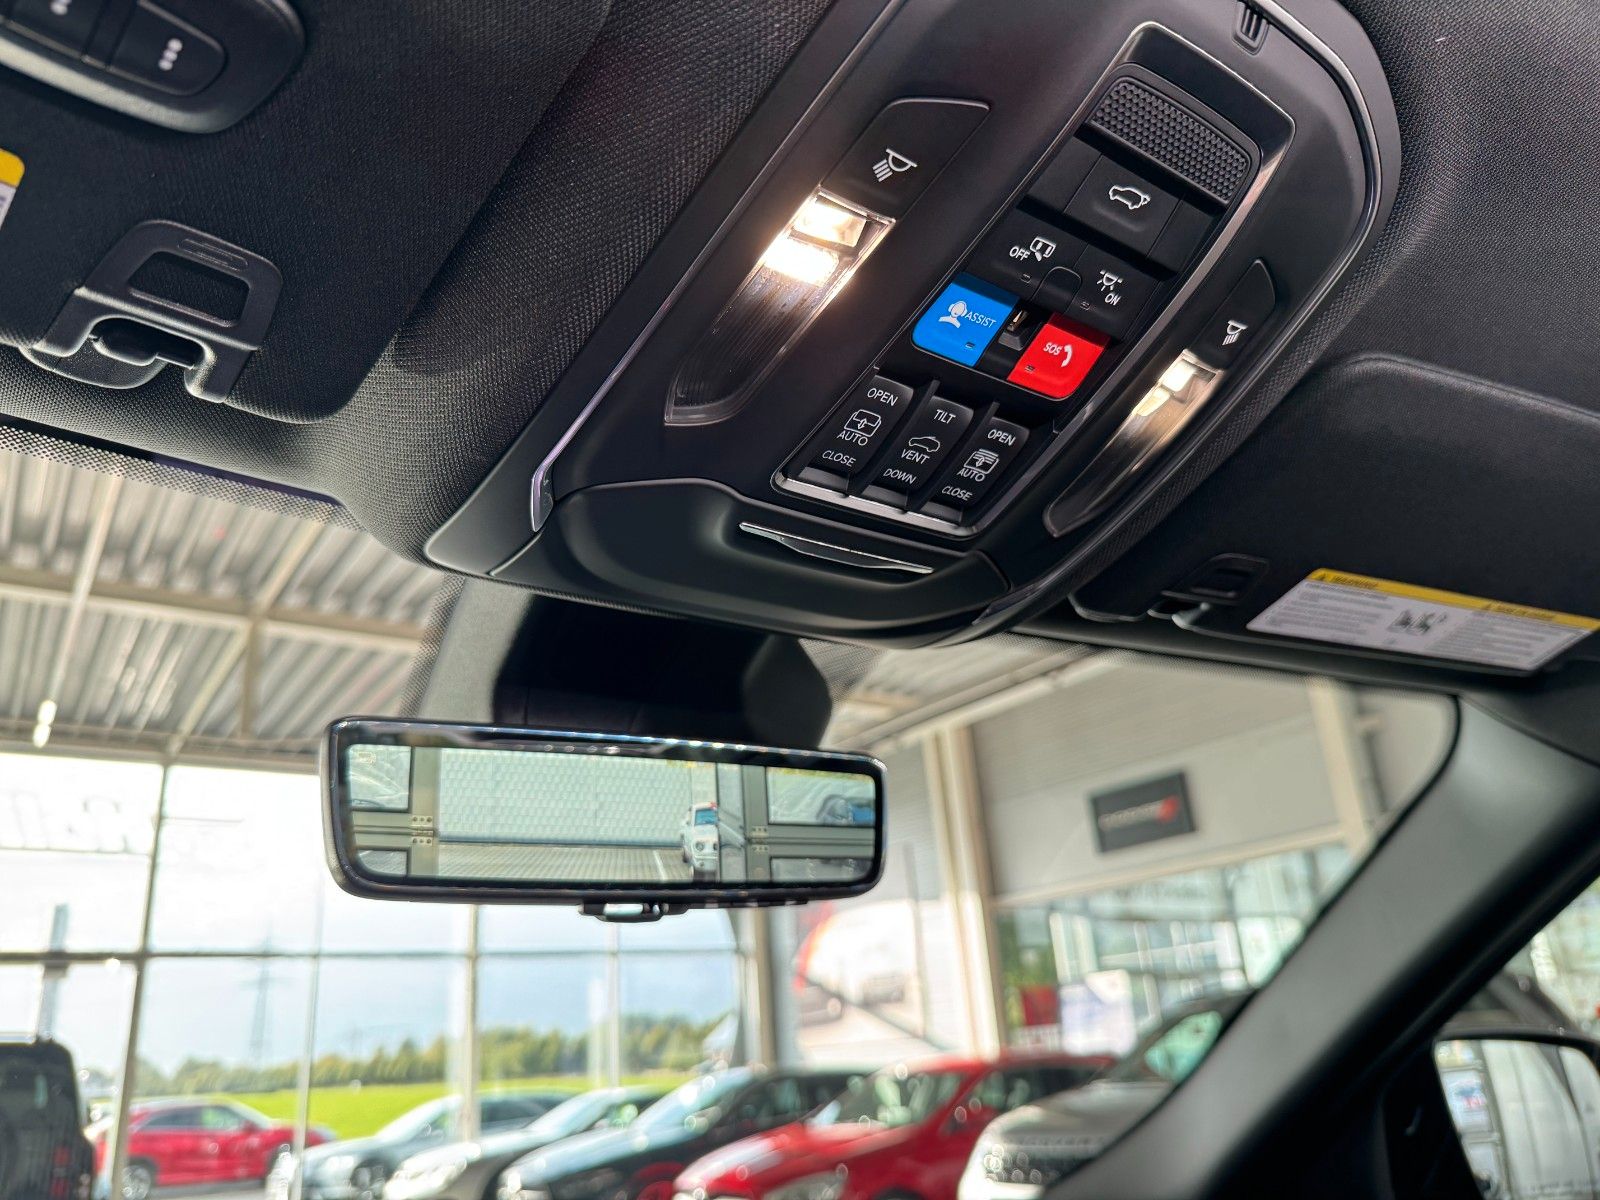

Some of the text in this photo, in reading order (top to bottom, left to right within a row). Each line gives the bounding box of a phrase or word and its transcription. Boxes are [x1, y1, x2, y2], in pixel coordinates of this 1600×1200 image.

[1009, 245, 1030, 261] OFF
[1104, 293, 1121, 306] ON
[965, 311, 996, 328] ASSIST
[1043, 341, 1063, 356] SOS
[867, 387, 898, 407] OPEN
[934, 409, 956, 424] TILT
[836, 430, 868, 446] AUTO
[987, 428, 1016, 446] OPEN
[822, 450, 856, 468] CLOSE
[901, 448, 930, 465] VENT
[883, 468, 917, 485] DOWN
[957, 468, 985, 482] AUTO
[942, 485, 973, 501] CLOSE
